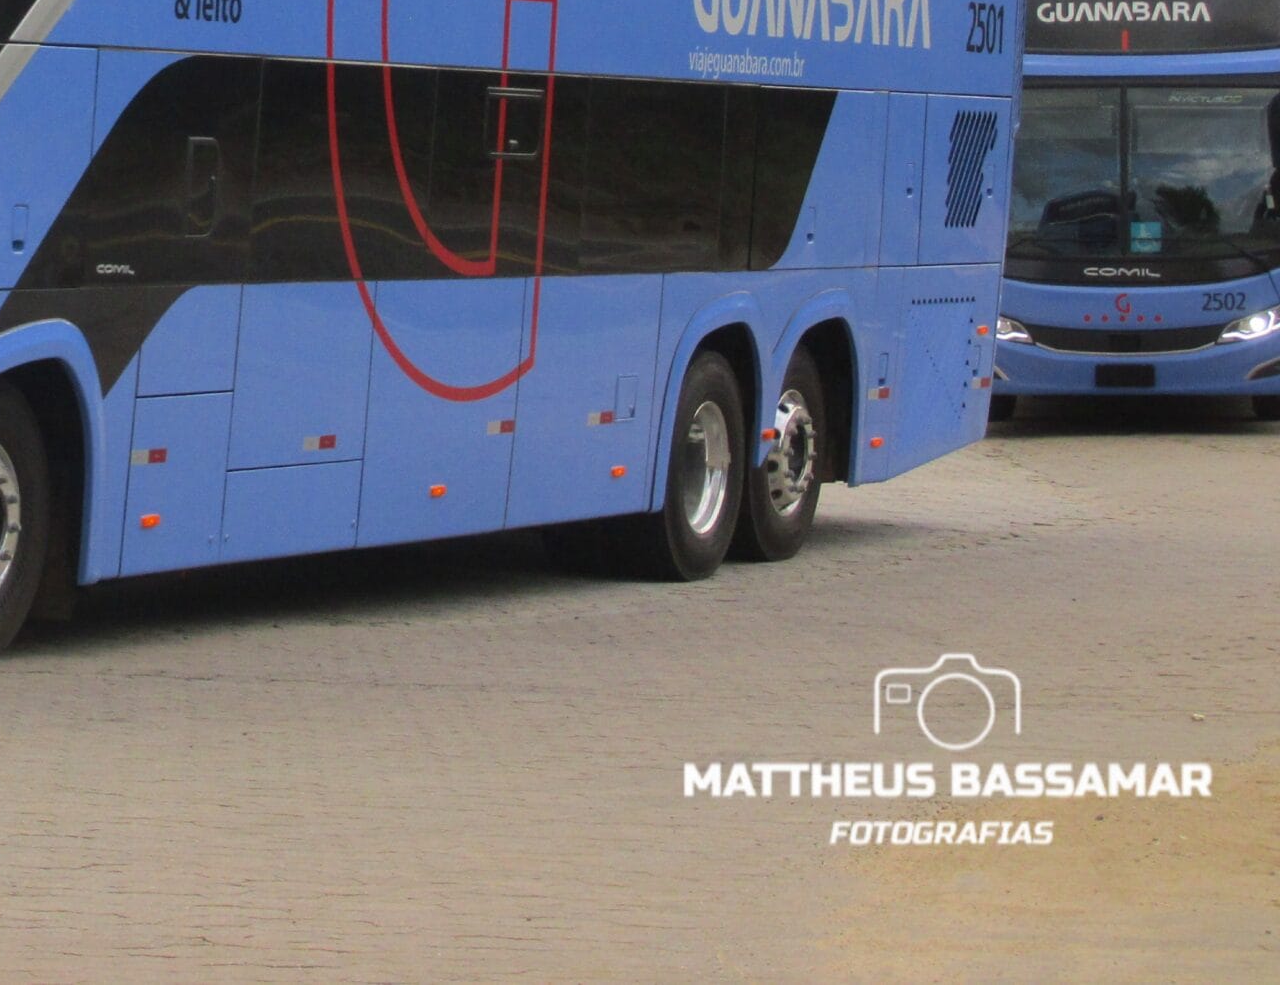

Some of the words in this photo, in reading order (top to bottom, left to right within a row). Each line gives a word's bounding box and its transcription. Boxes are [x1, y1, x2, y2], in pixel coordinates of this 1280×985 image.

[1037, 2, 1211, 22] GUANABARA
[966, 1, 1005, 54] 2501
[688, 45, 805, 79] viajeguanabara.com.br
[96, 264, 135, 275] COMIL
[1083, 267, 1161, 278] COMIL
[1202, 292, 1246, 312] 2502
